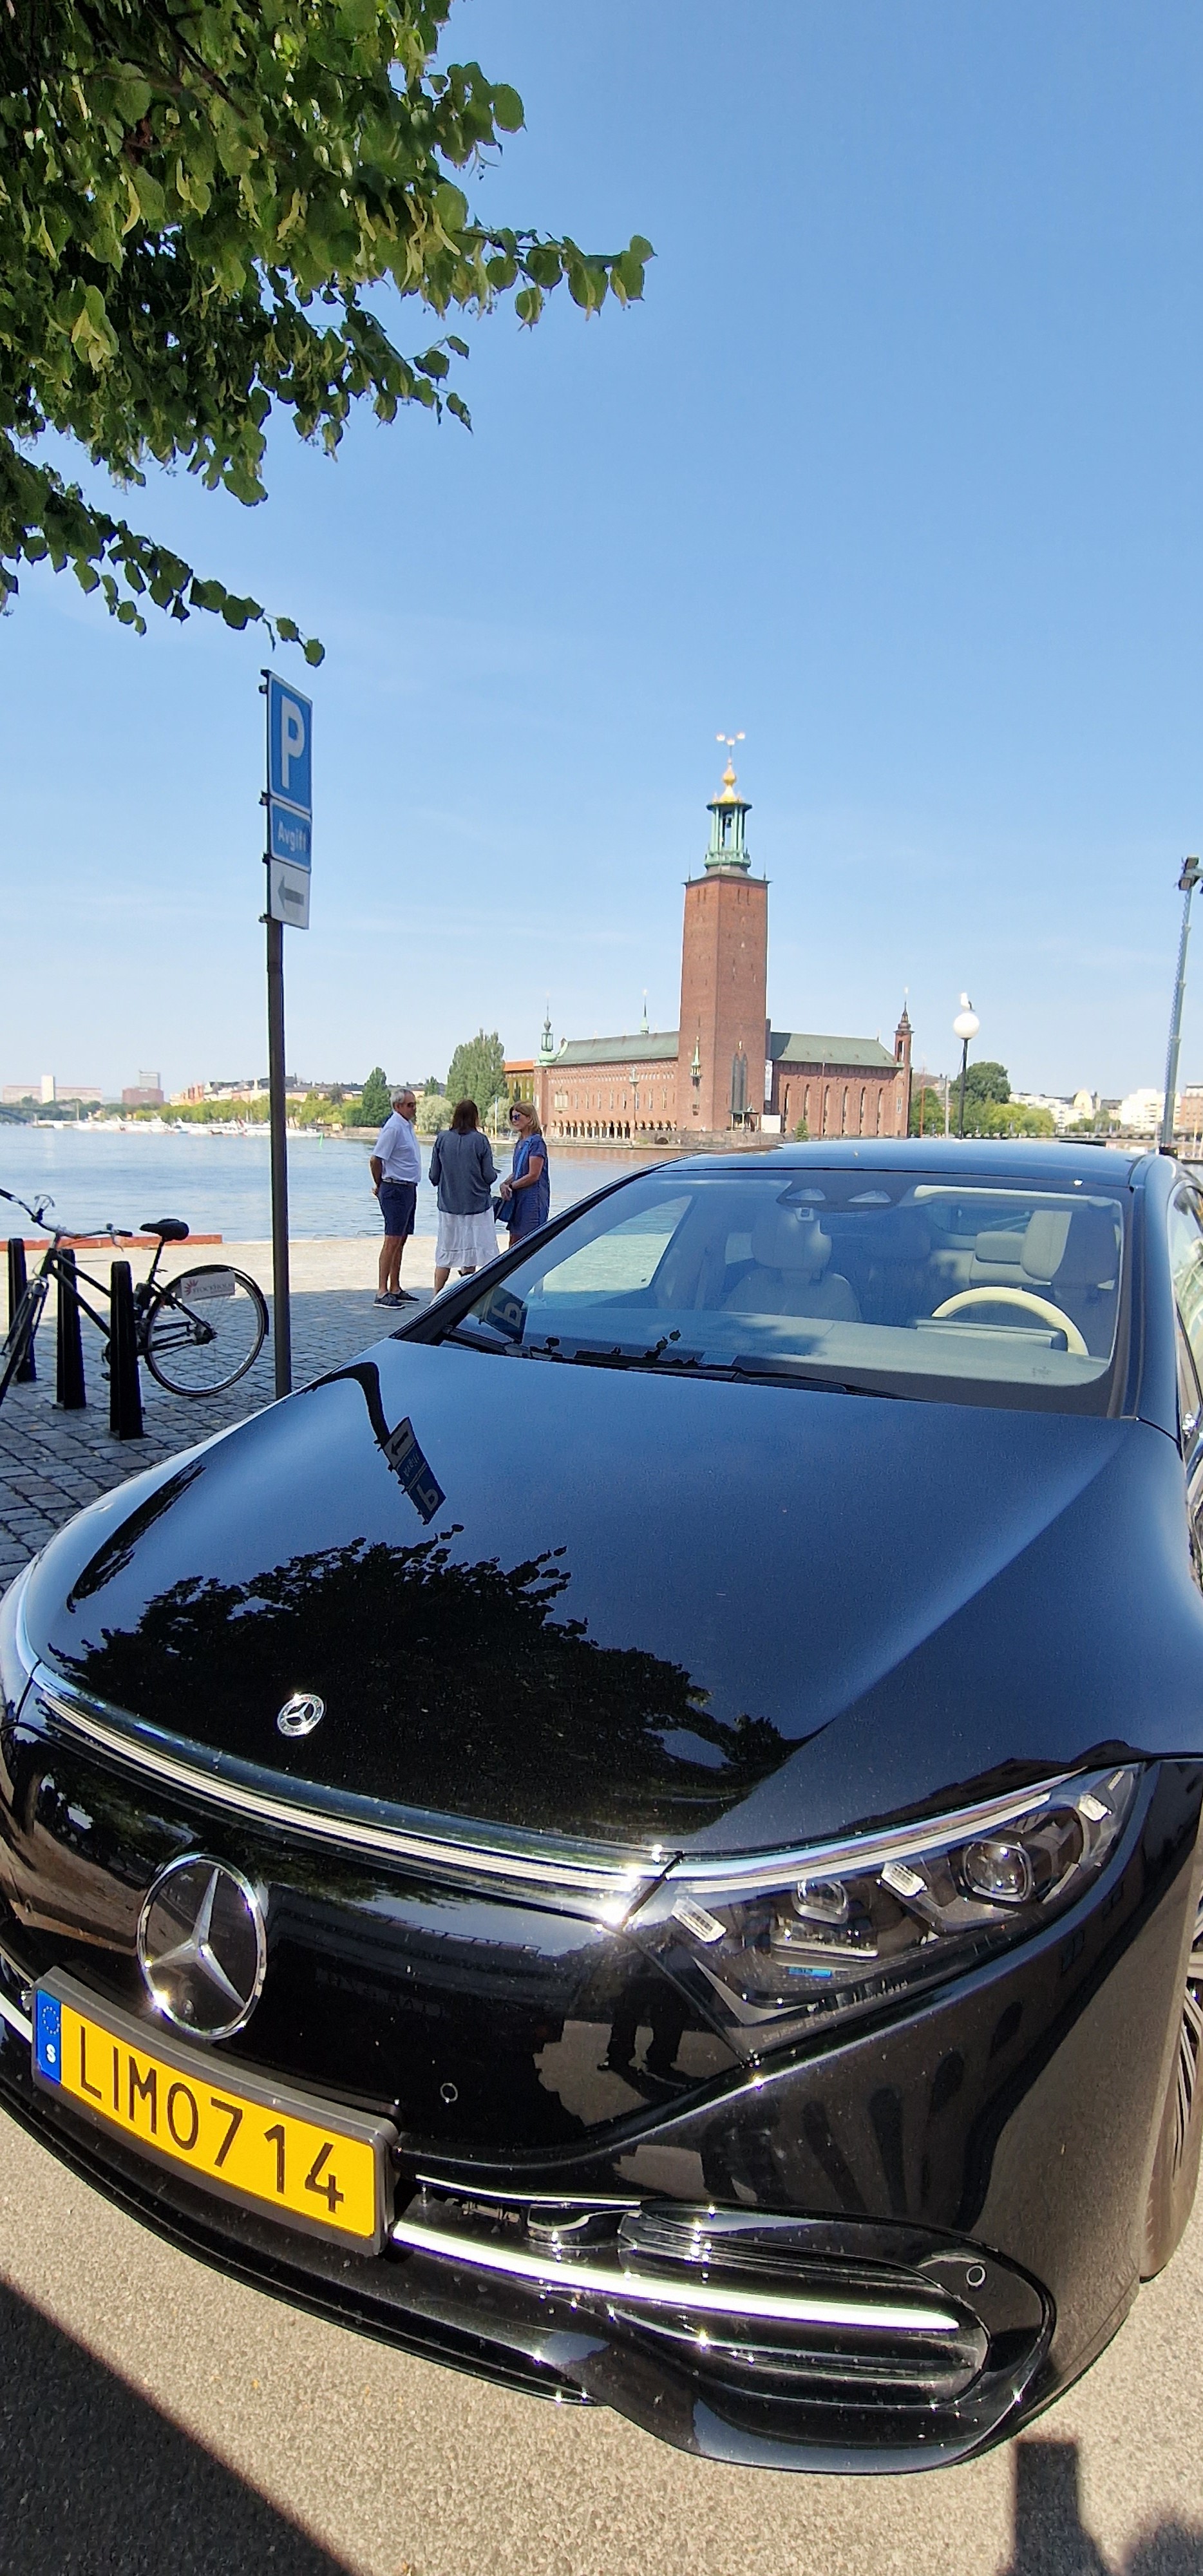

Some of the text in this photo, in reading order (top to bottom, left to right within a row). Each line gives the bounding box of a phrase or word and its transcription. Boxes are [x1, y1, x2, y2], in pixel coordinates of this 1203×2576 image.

[281, 695, 305, 790] P
[278, 820, 307, 852] Avgift
[46, 2043, 57, 2064] S
